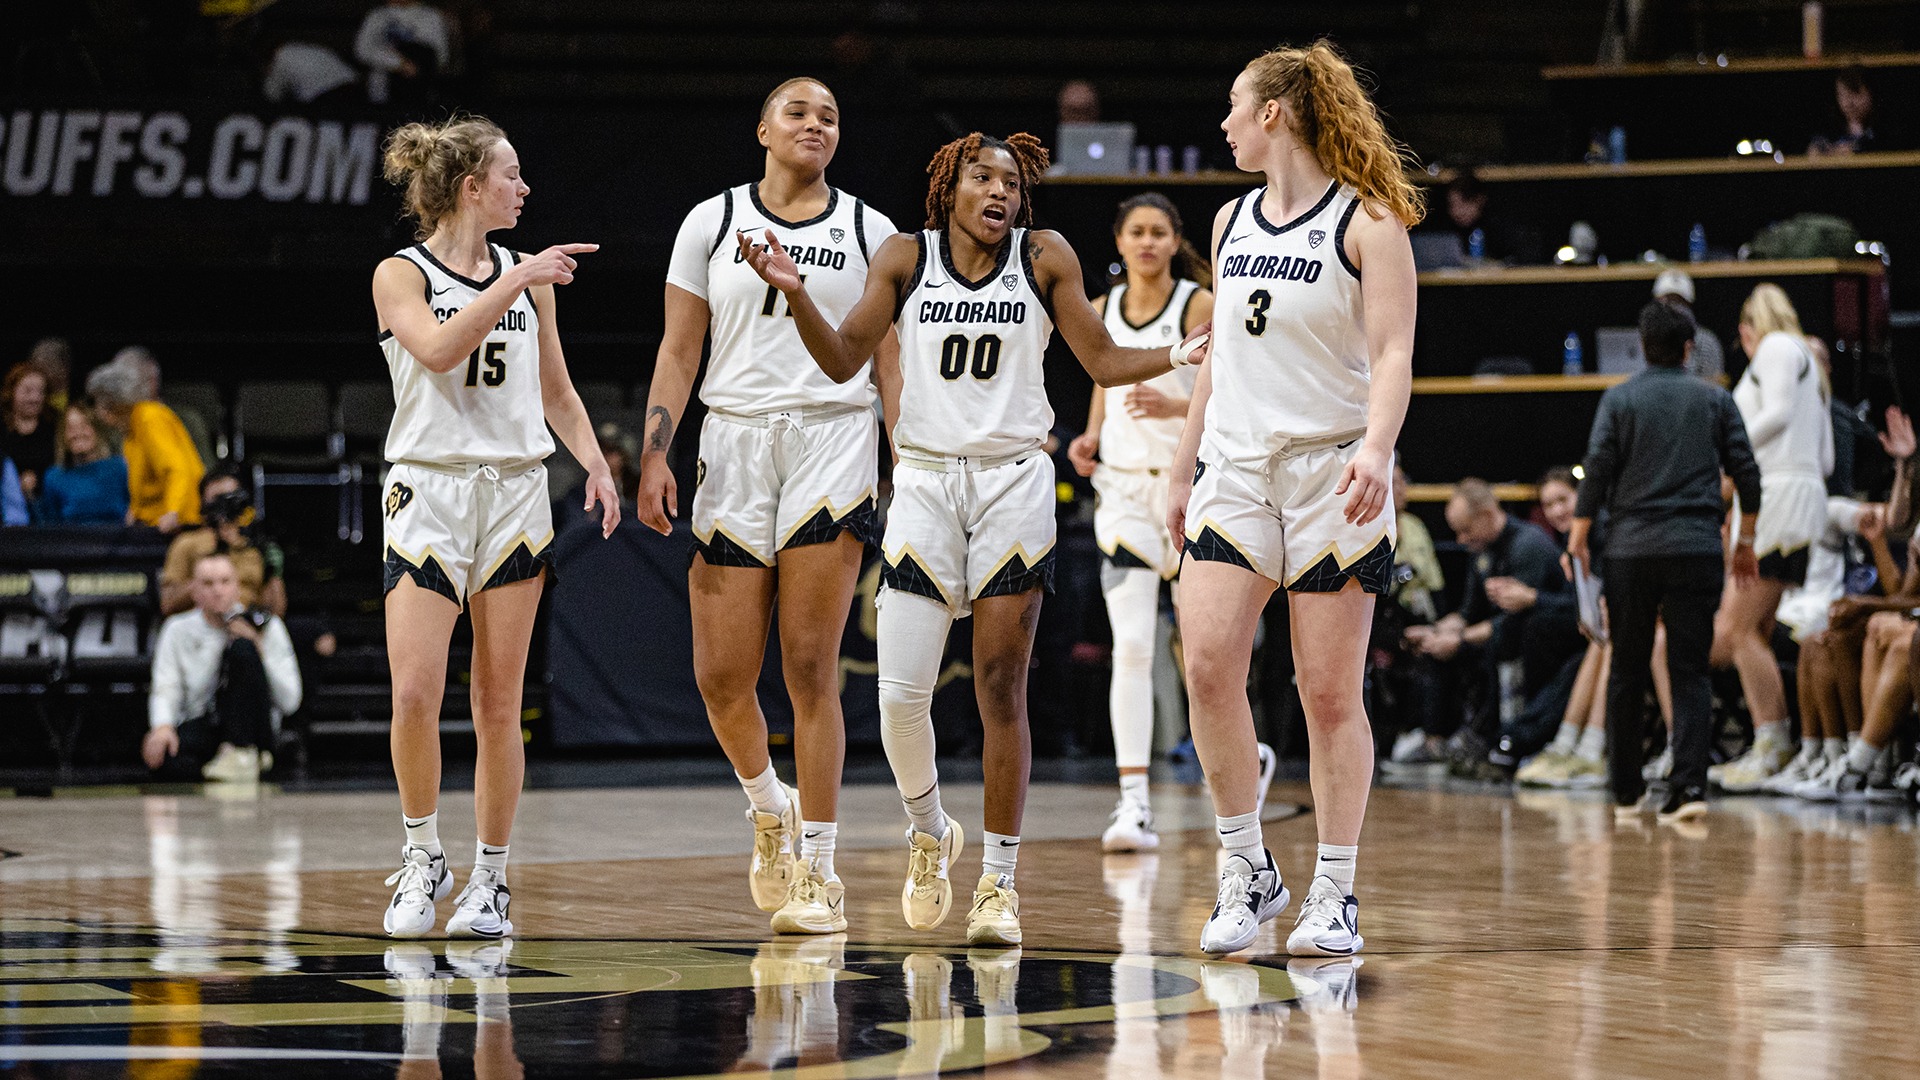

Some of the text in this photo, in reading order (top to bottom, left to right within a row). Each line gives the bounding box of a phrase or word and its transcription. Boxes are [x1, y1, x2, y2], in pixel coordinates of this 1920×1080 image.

[0, 112, 379, 204] UFFS.COM
[1222, 254, 1323, 284] COLORADO
[919, 300, 1027, 325] COLORADO
[1245, 289, 1272, 338] 3
[940, 333, 1001, 382] 00
